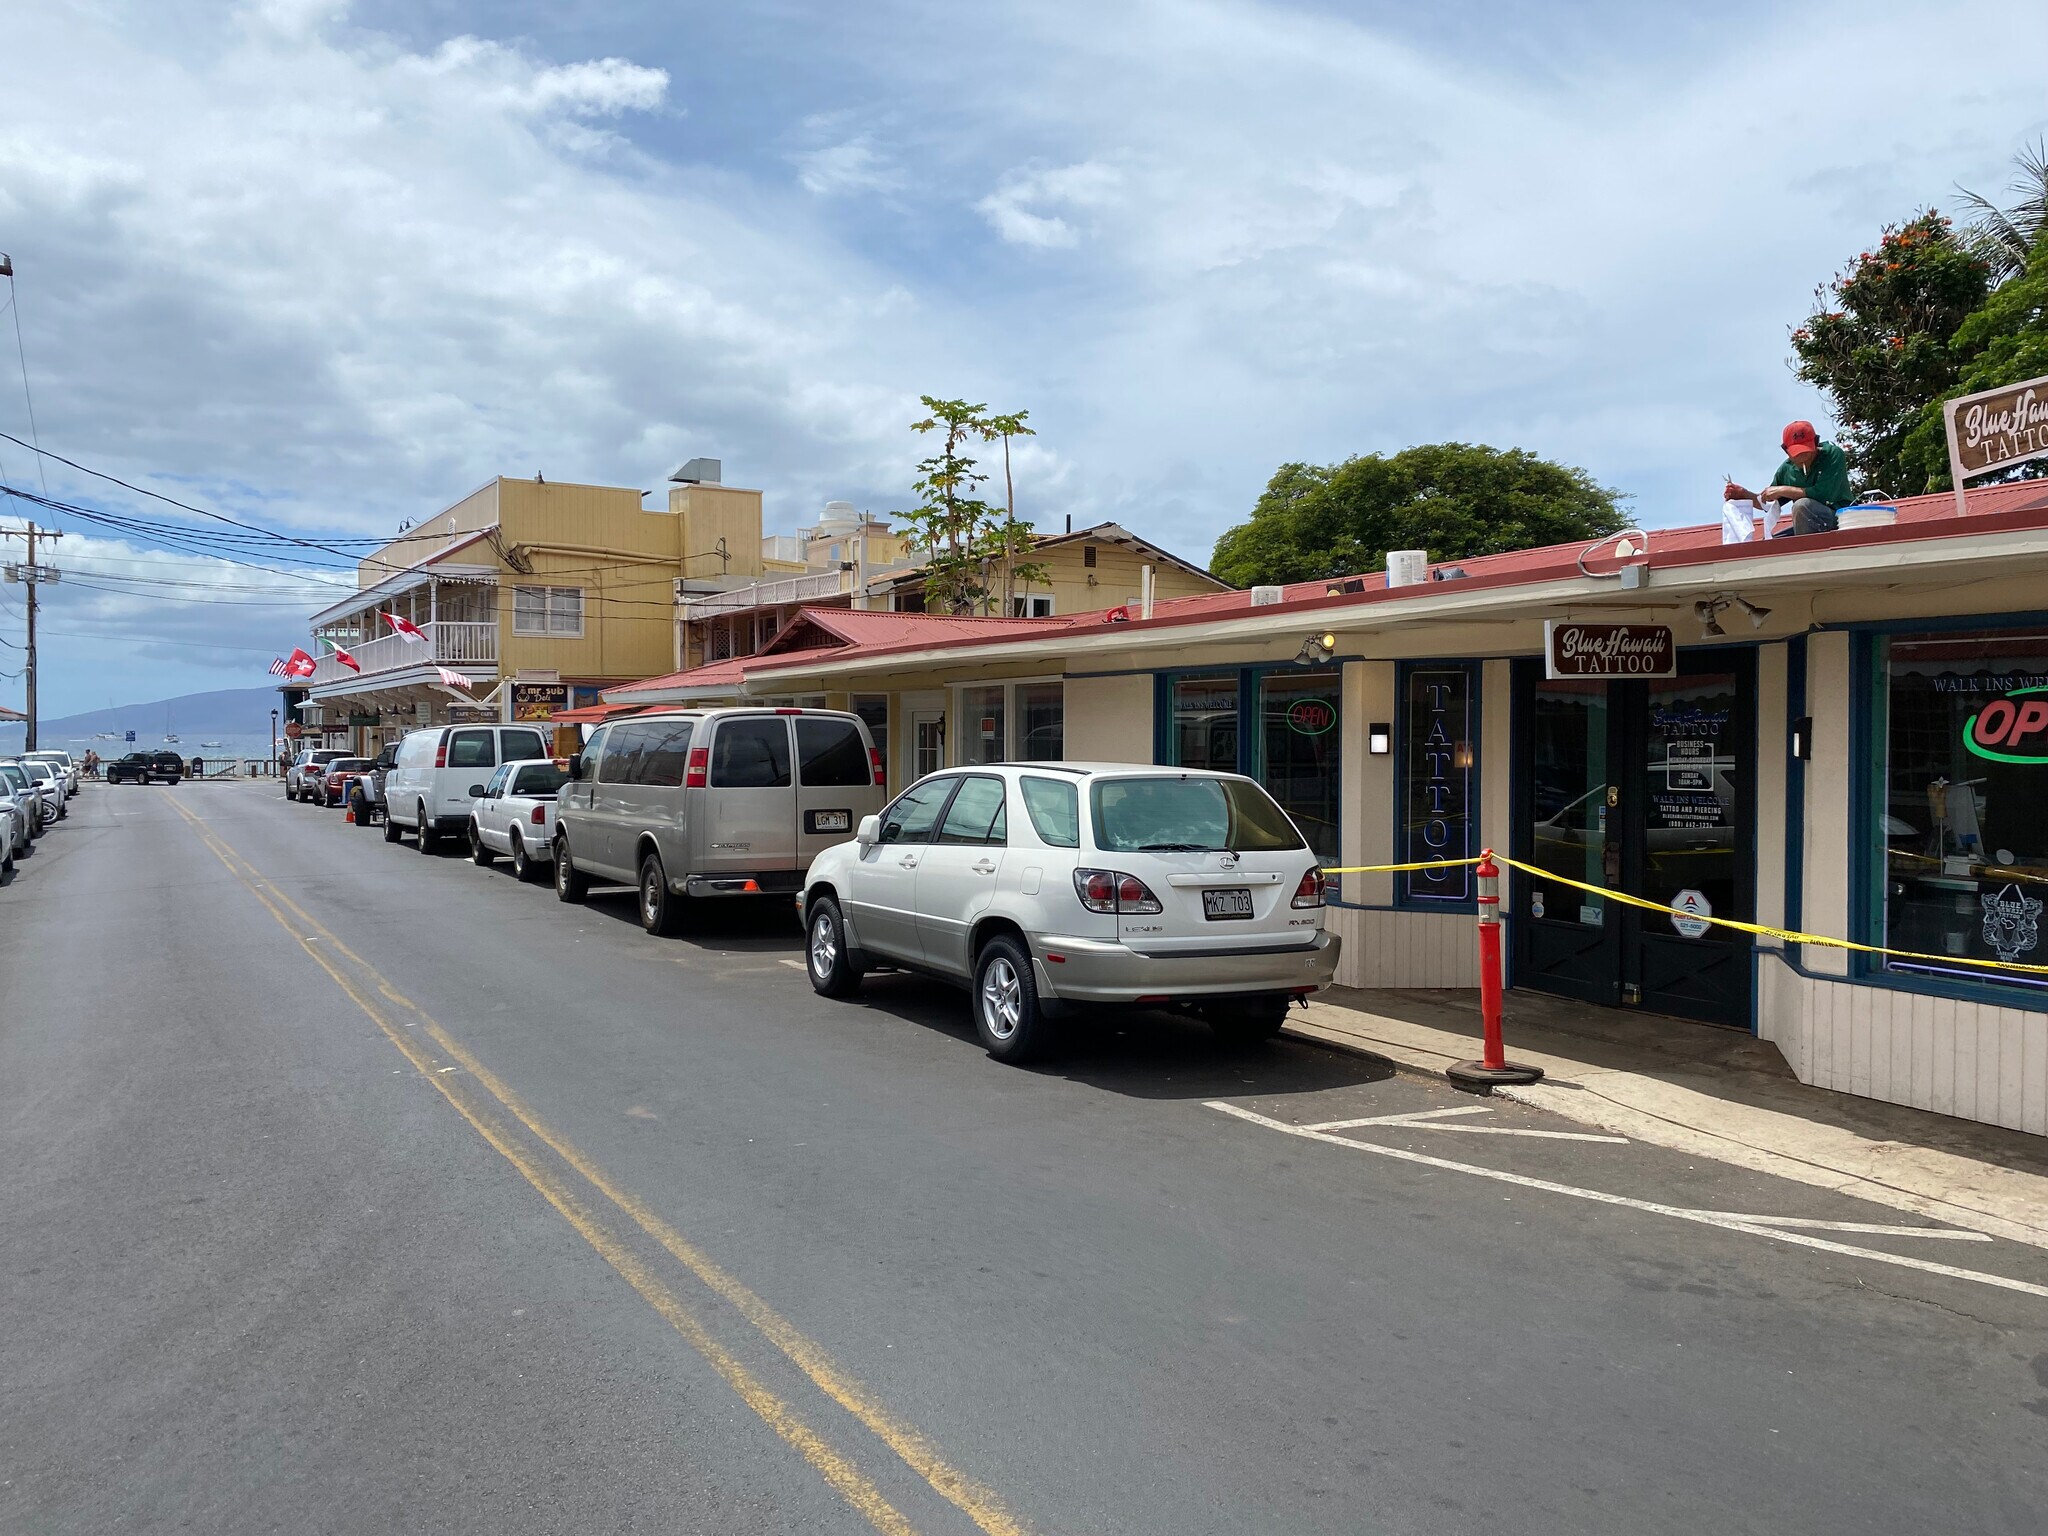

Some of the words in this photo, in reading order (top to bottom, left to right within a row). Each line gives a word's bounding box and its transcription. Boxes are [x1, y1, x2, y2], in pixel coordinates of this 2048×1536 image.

[1965, 404, 2010, 448] Blue
[1562, 628, 1604, 658] Blue
[1600, 627, 1665, 658] Hawaii
[1574, 655, 1654, 673] TATTOO
[545, 686, 564, 695] sub
[1934, 678, 1979, 692] WALK
[1985, 677, 2013, 691] INS
[534, 694, 551, 702] Deli
[1293, 705, 1328, 726] OPEN
[1661, 723, 1719, 736] TATTOO
[1676, 740, 1704, 748] BUSINESS
[1680, 748, 1700, 756] HOURS
[1424, 684, 1453, 881] TATTOO
[1652, 795, 1675, 804] WALK
[1676, 796, 1690, 804] INS
[1691, 796, 1730, 806] WELCOME
[1694, 806, 1721, 814] PIERCING
[816, 815, 830, 826] LGM
[833, 815, 846, 825] 317
[1206, 896, 1226, 912] MKZ
[1230, 896, 1251, 912] 703
[1999, 900, 2021, 909] BLUE
